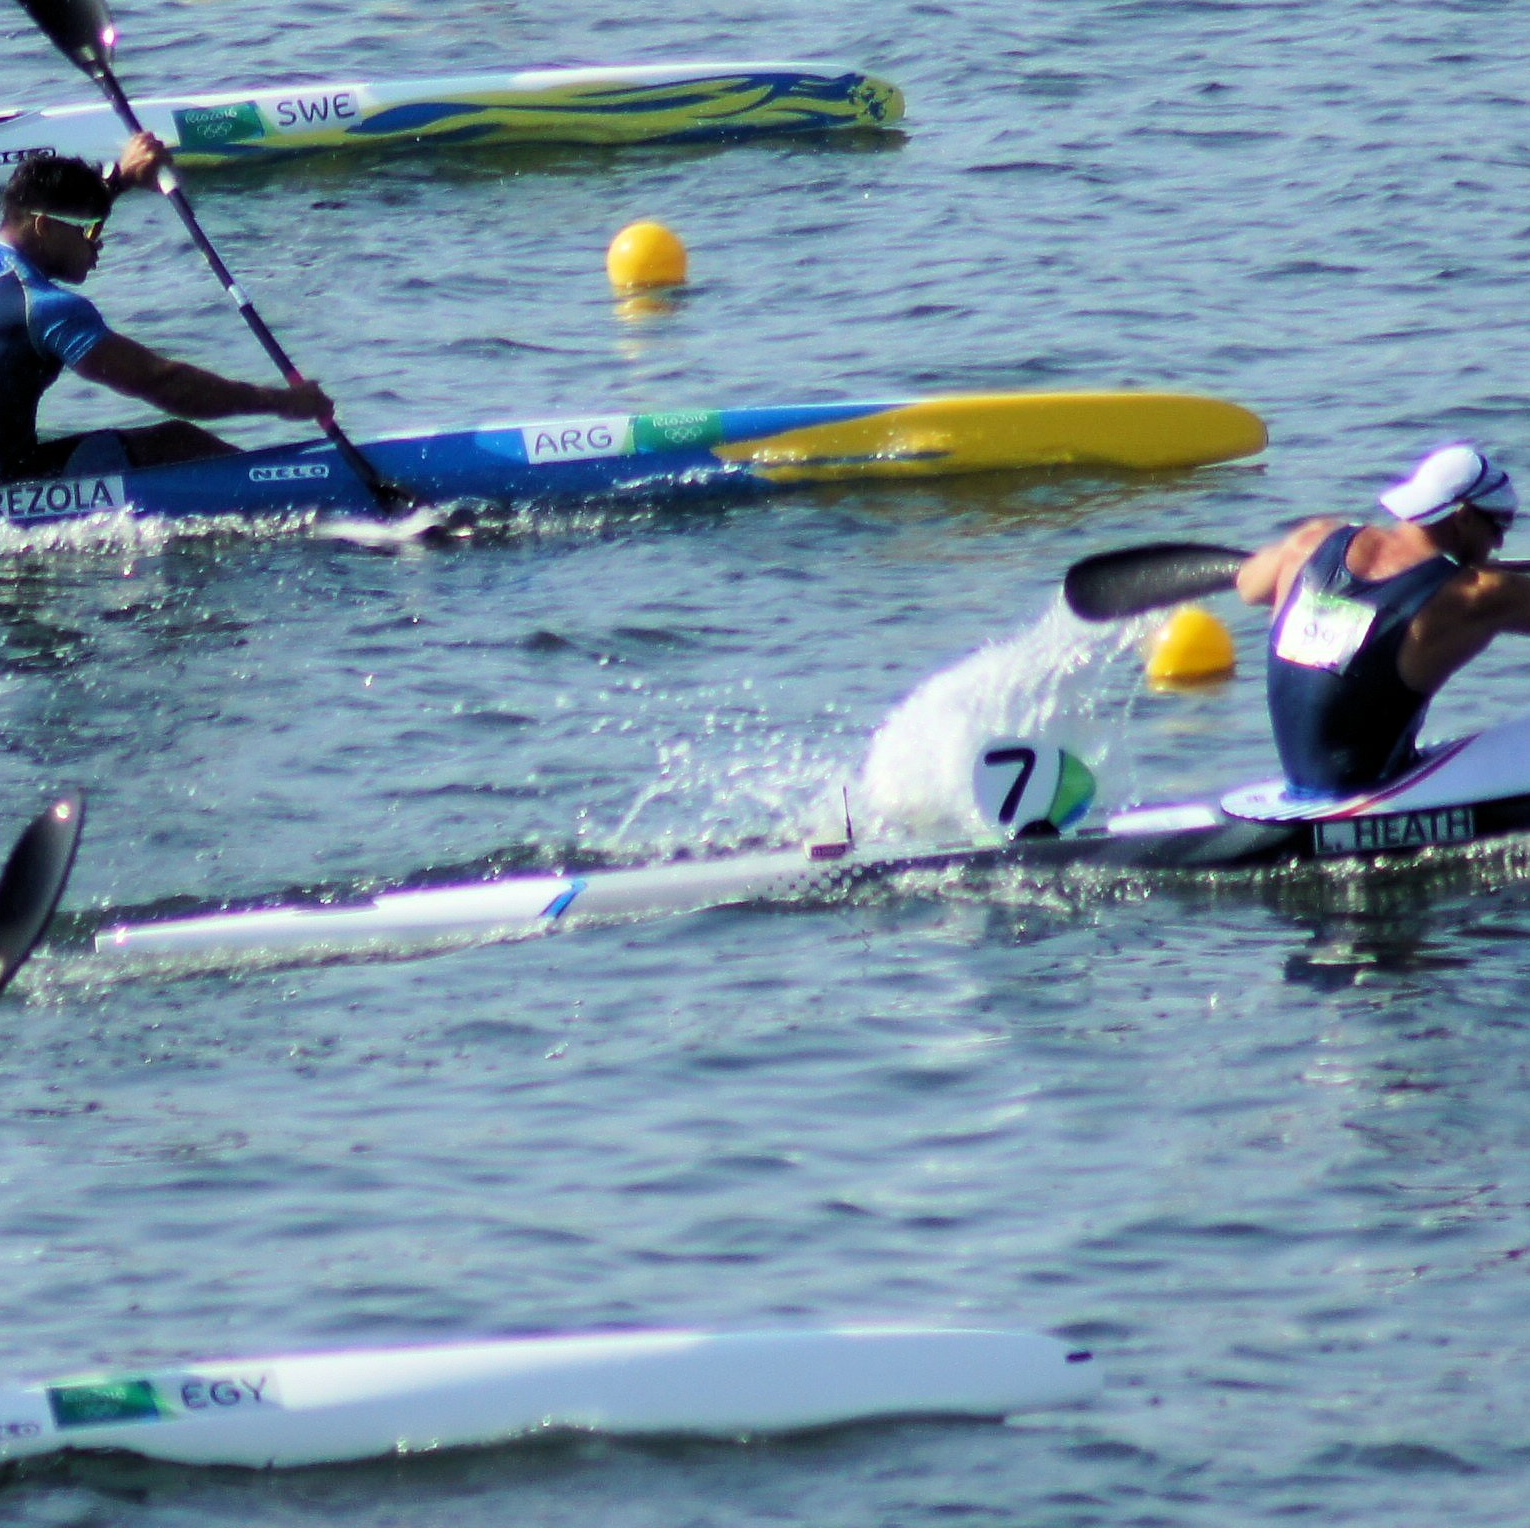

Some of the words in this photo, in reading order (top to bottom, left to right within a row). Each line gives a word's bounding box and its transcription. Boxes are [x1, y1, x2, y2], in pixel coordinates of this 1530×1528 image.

[276, 93, 356, 126] SWE
[535, 425, 613, 456] ARG
[984, 747, 1036, 825] 7
[1319, 822, 1342, 852] L.
[1355, 808, 1471, 849] HEATH
[181, 1376, 267, 1410] EGY
